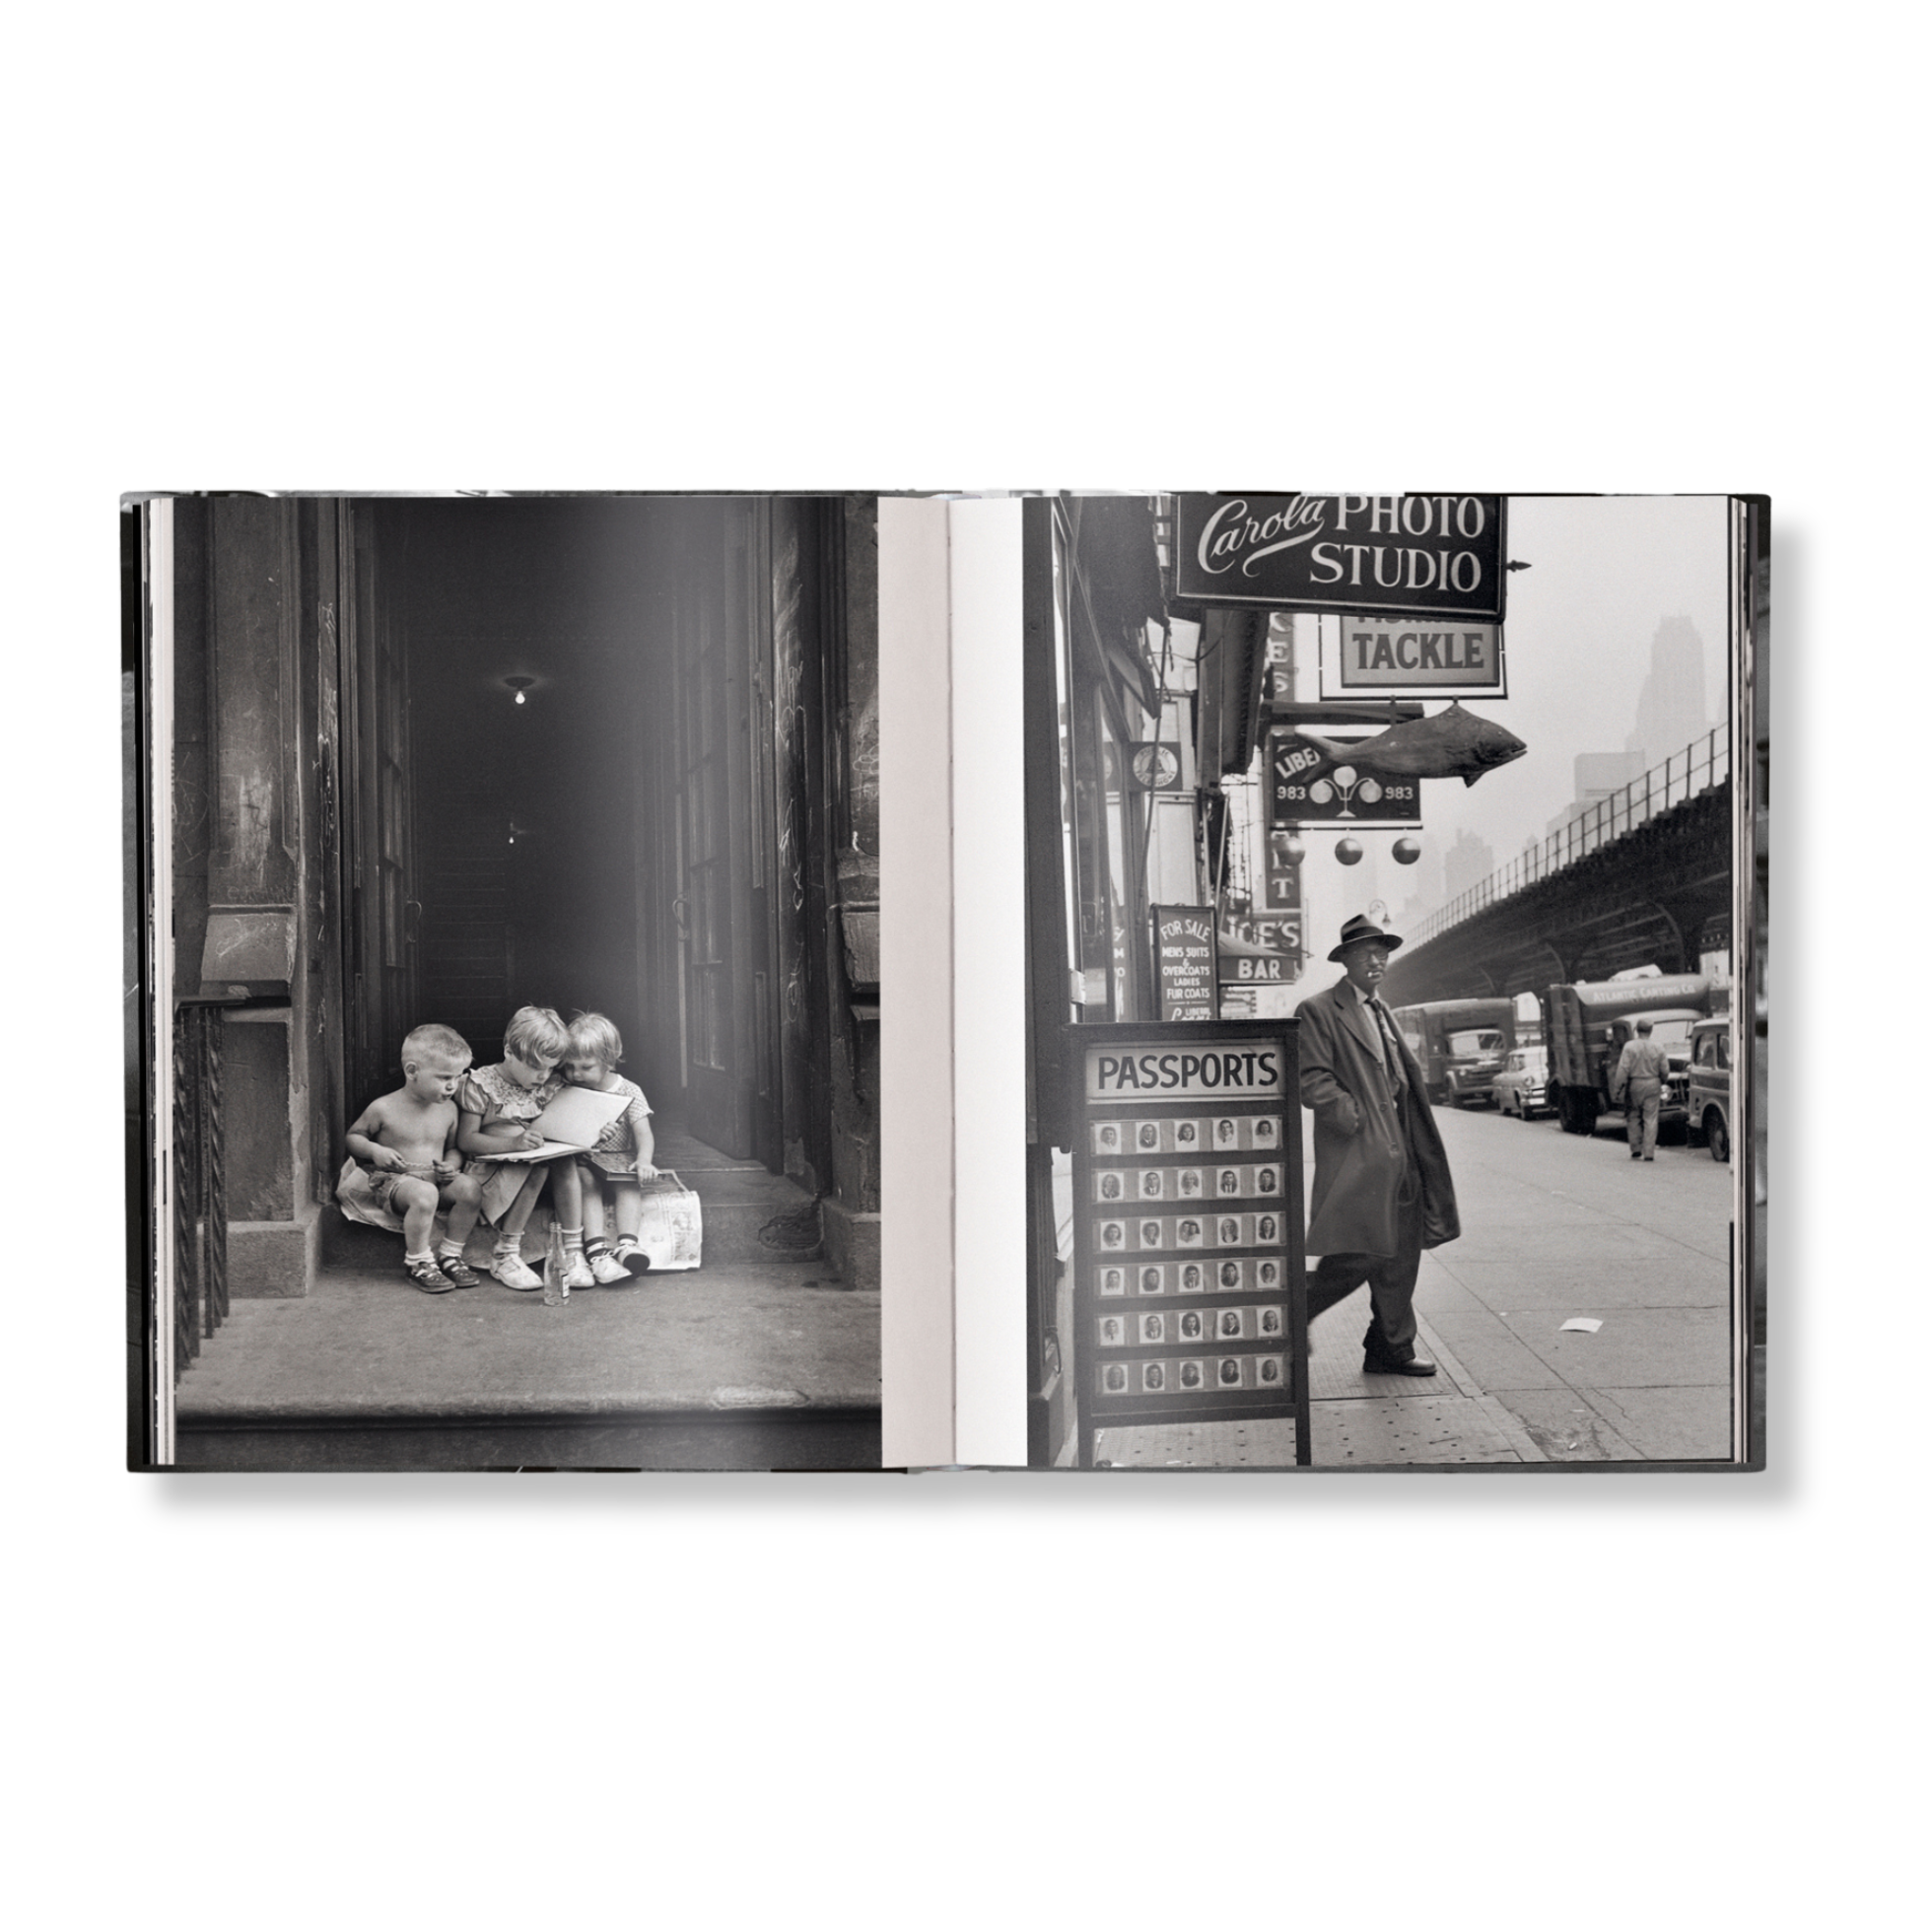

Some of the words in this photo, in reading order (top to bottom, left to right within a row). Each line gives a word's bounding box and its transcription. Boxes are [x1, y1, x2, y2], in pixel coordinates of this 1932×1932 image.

[1198, 495, 1327, 577] Carola
[1335, 496, 1485, 538] PHOTO
[1309, 541, 1482, 592] STUDIO
[1352, 632, 1484, 669] TACKLE
[1276, 786, 1306, 800] 983
[1385, 787, 1414, 800] 983
[1160, 920, 1183, 940] FOR
[1185, 918, 1211, 942] SALE
[1185, 946, 1209, 957] SUITS
[1162, 966, 1210, 976] OVERCOATS
[1238, 959, 1281, 979] BAR
[1173, 977, 1201, 987] LADIES
[1166, 988, 1183, 999] FUR
[1184, 988, 1210, 999] COATS
[1098, 1052, 1278, 1089] PASSPORTS
